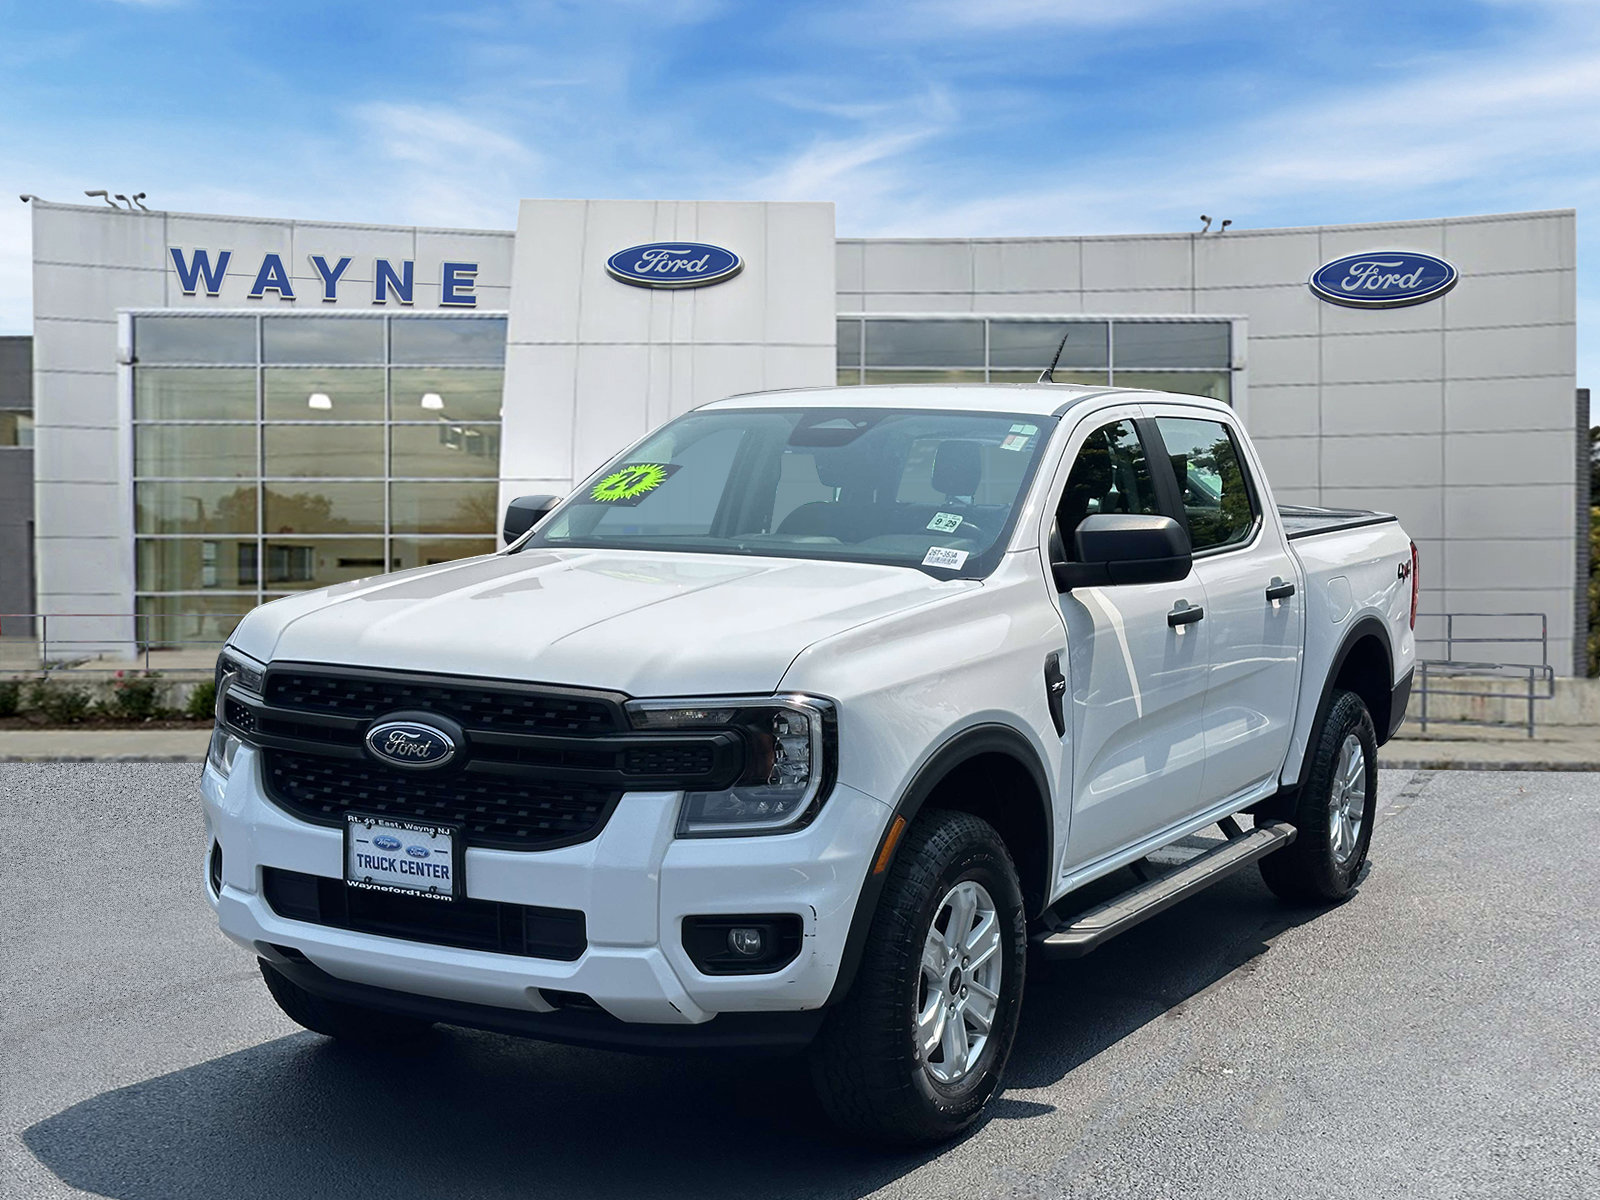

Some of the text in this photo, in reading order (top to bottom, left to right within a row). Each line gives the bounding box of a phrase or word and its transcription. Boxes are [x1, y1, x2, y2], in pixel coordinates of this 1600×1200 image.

[634, 248, 710, 273] Ford
[169, 246, 479, 306] WAYNE
[1341, 261, 1424, 291] Ford
[384, 730, 432, 758] Ford
[347, 815, 361, 823] Rt.
[404, 822, 436, 834] Wayne
[357, 853, 450, 880] TRUCK CENTER
[346, 880, 453, 902] Wayneford1.com
